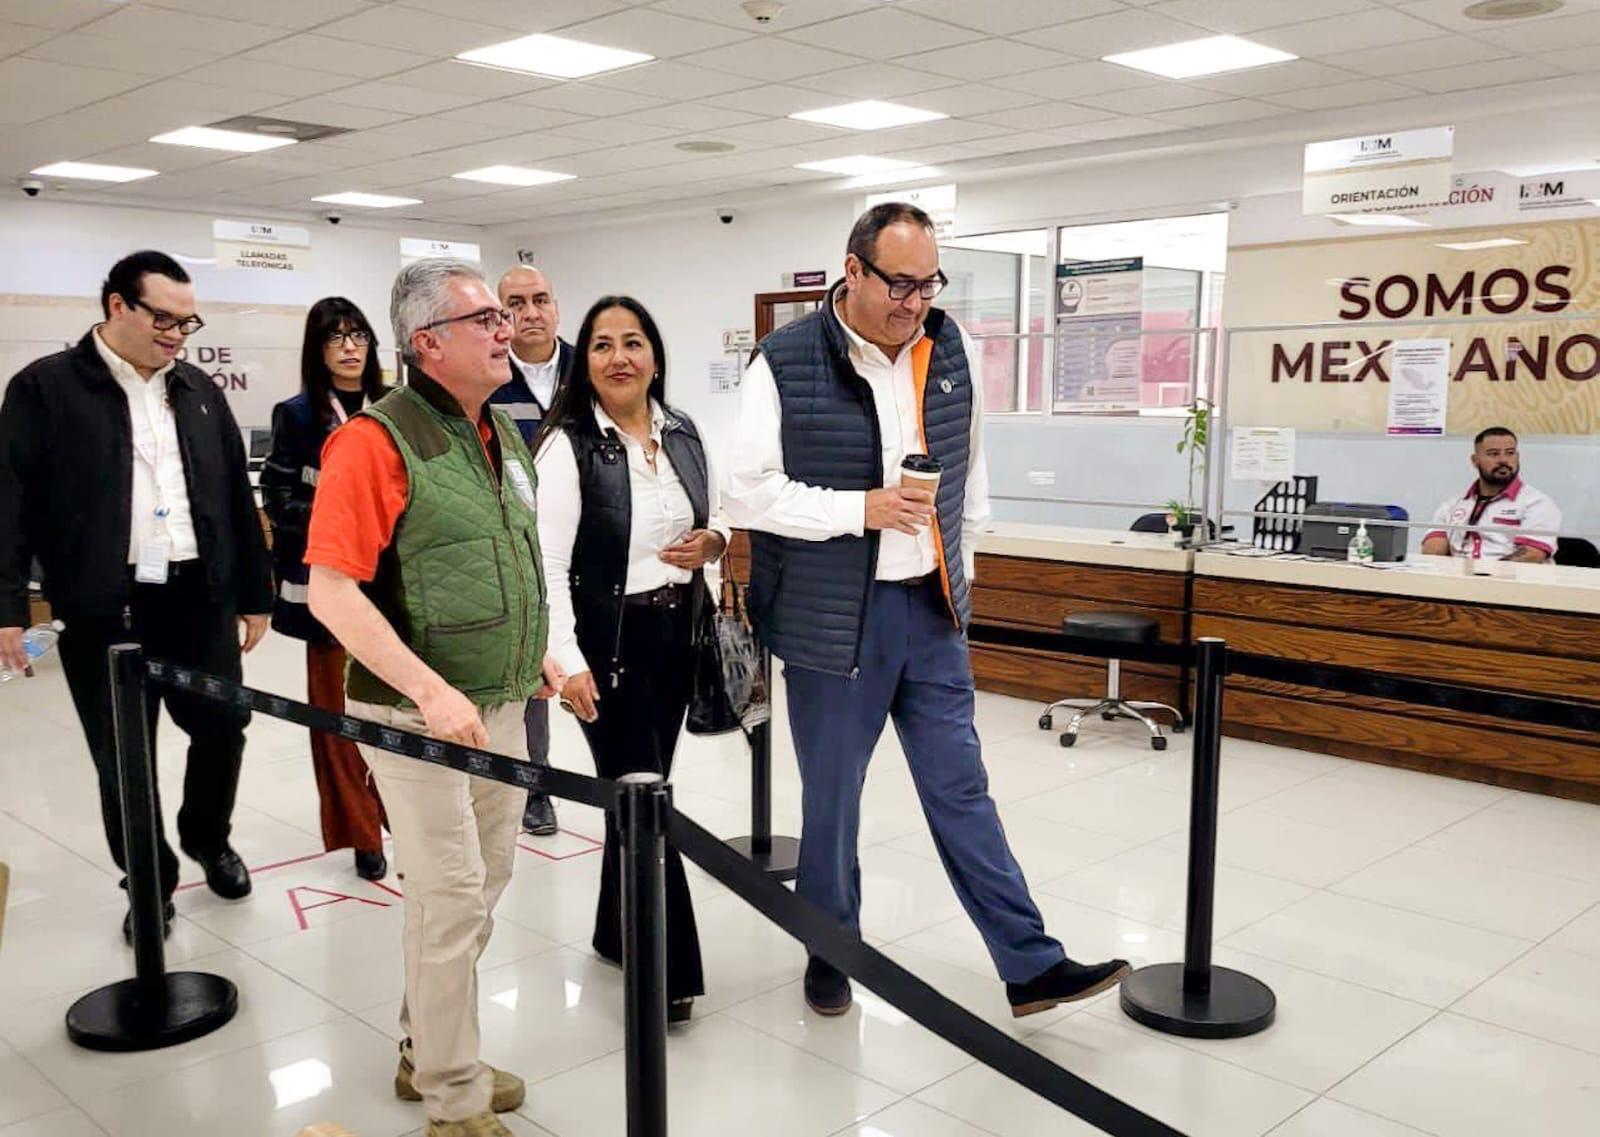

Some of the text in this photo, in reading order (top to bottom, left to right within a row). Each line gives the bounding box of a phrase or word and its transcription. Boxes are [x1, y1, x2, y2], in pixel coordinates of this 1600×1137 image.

[1330, 184, 1420, 205] ORIENTACIÓN
[235, 259, 294, 271] TELEFÓNICAS
[240, 250, 288, 261] LLAMADAS
[1337, 265, 1572, 321] SOMOS
[198, 346, 232, 364] DE
[1271, 333, 1600, 384] MEXANO
